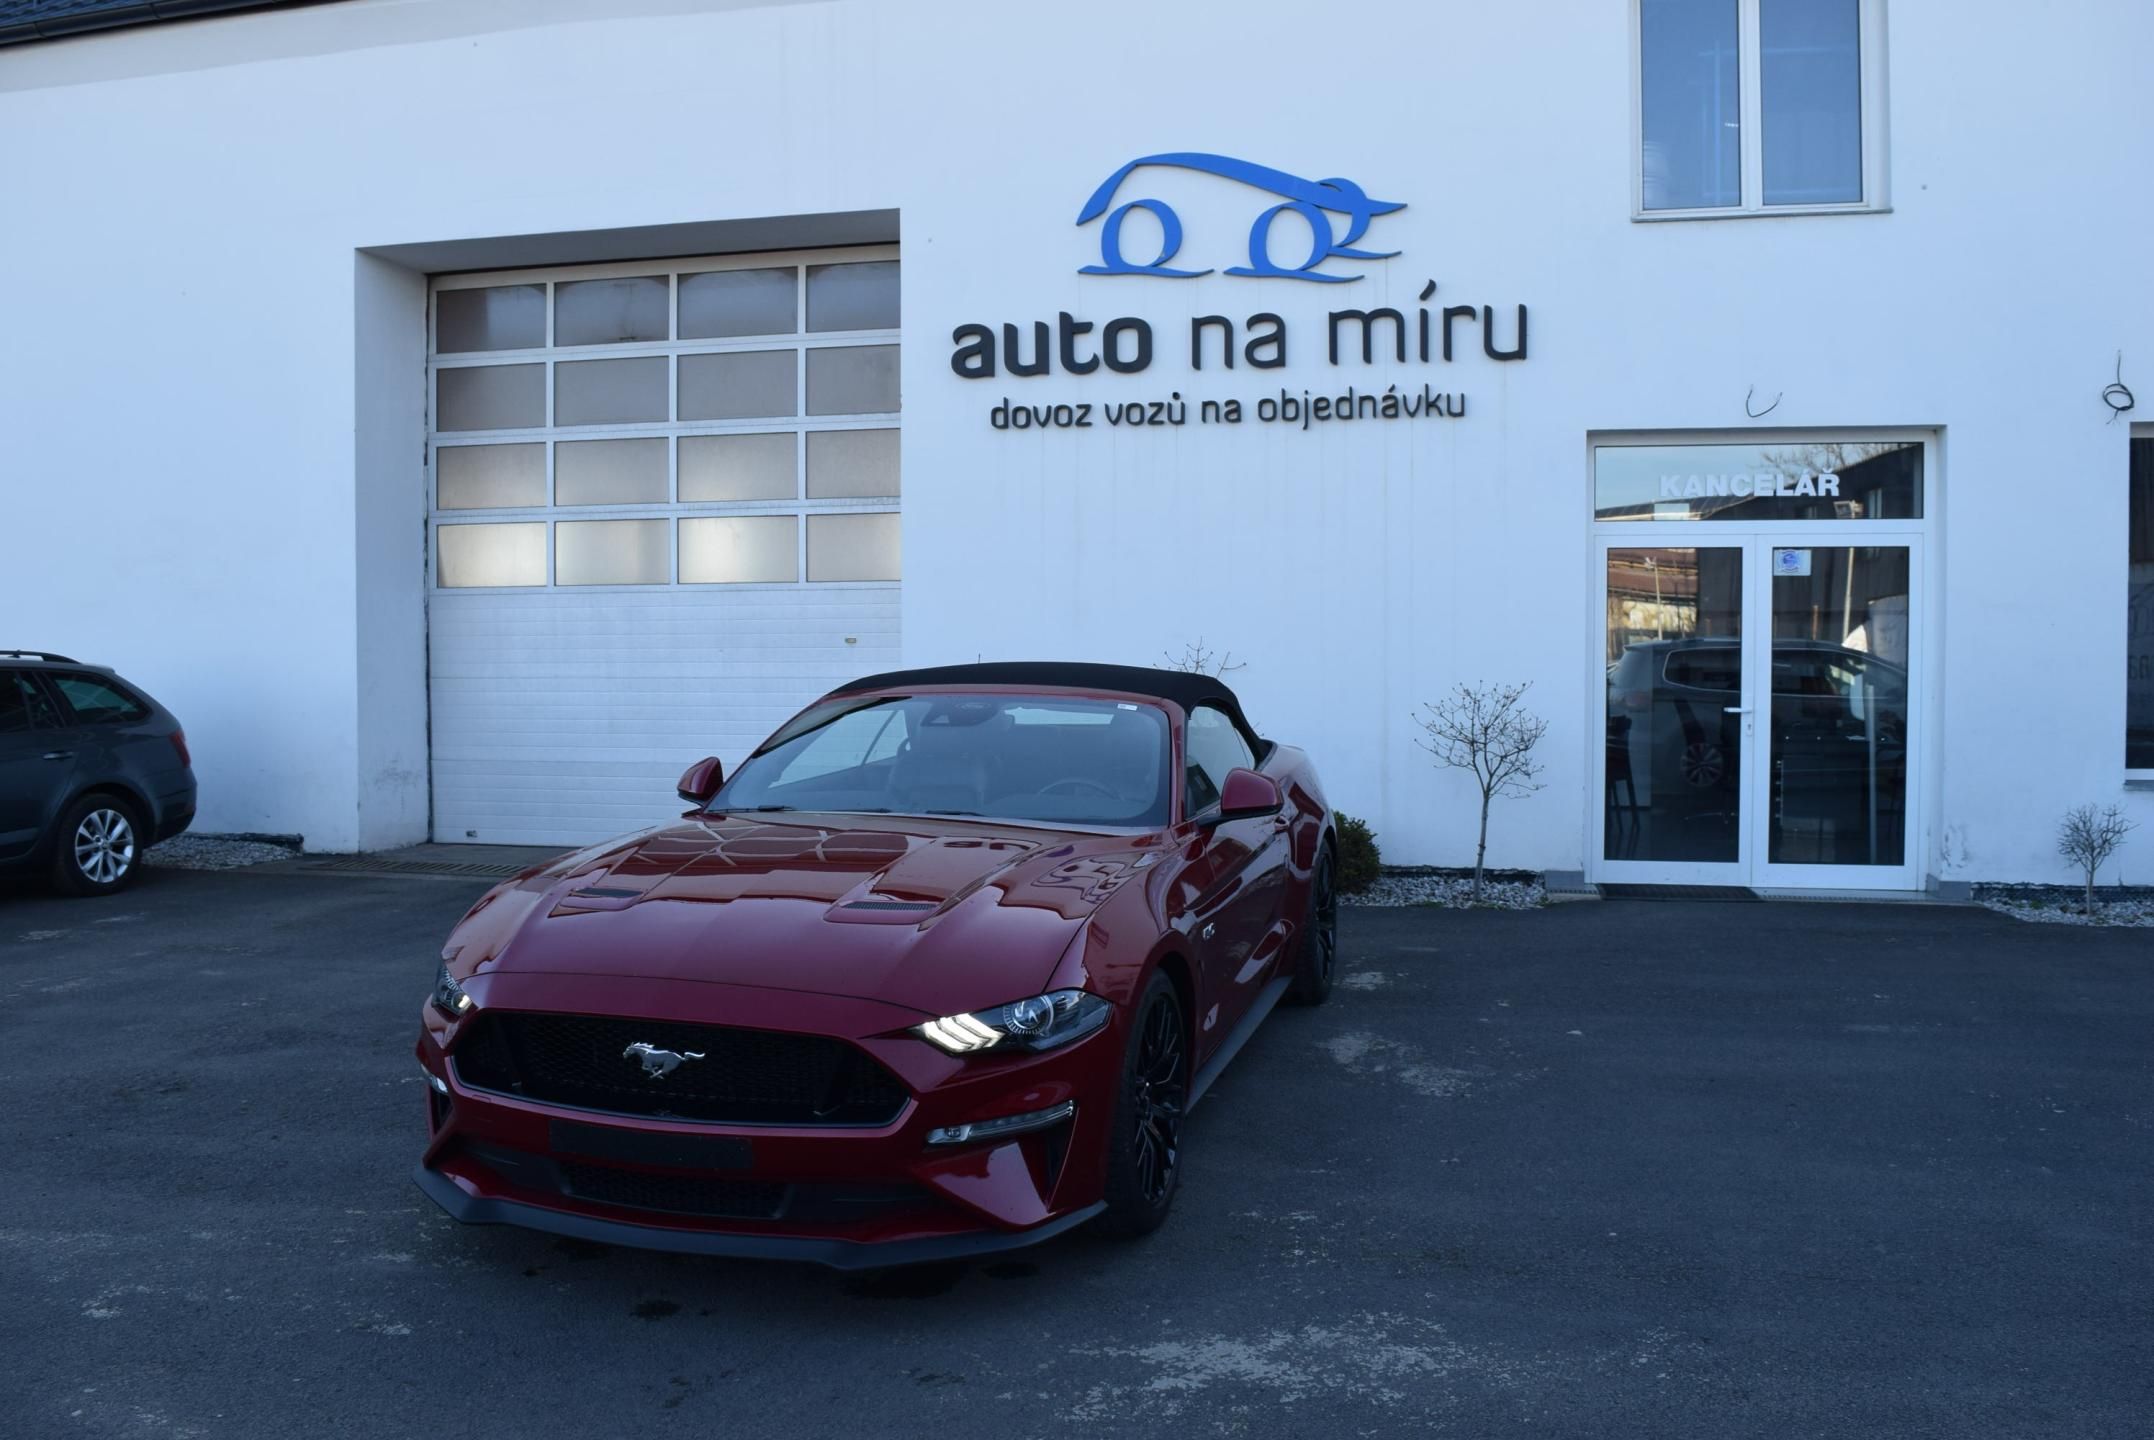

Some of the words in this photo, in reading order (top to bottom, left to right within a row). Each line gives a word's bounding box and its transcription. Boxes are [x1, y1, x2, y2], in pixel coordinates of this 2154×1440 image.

[950, 311, 1153, 379] auto
[1191, 312, 1287, 371] na
[1328, 278, 1528, 366] míru
[990, 396, 1093, 430] dovoz
[1104, 391, 1186, 427] vozů
[1201, 399, 1243, 424] na
[1257, 383, 1467, 431] objednávku
[1659, 467, 1840, 497] KANCELÁŘ
